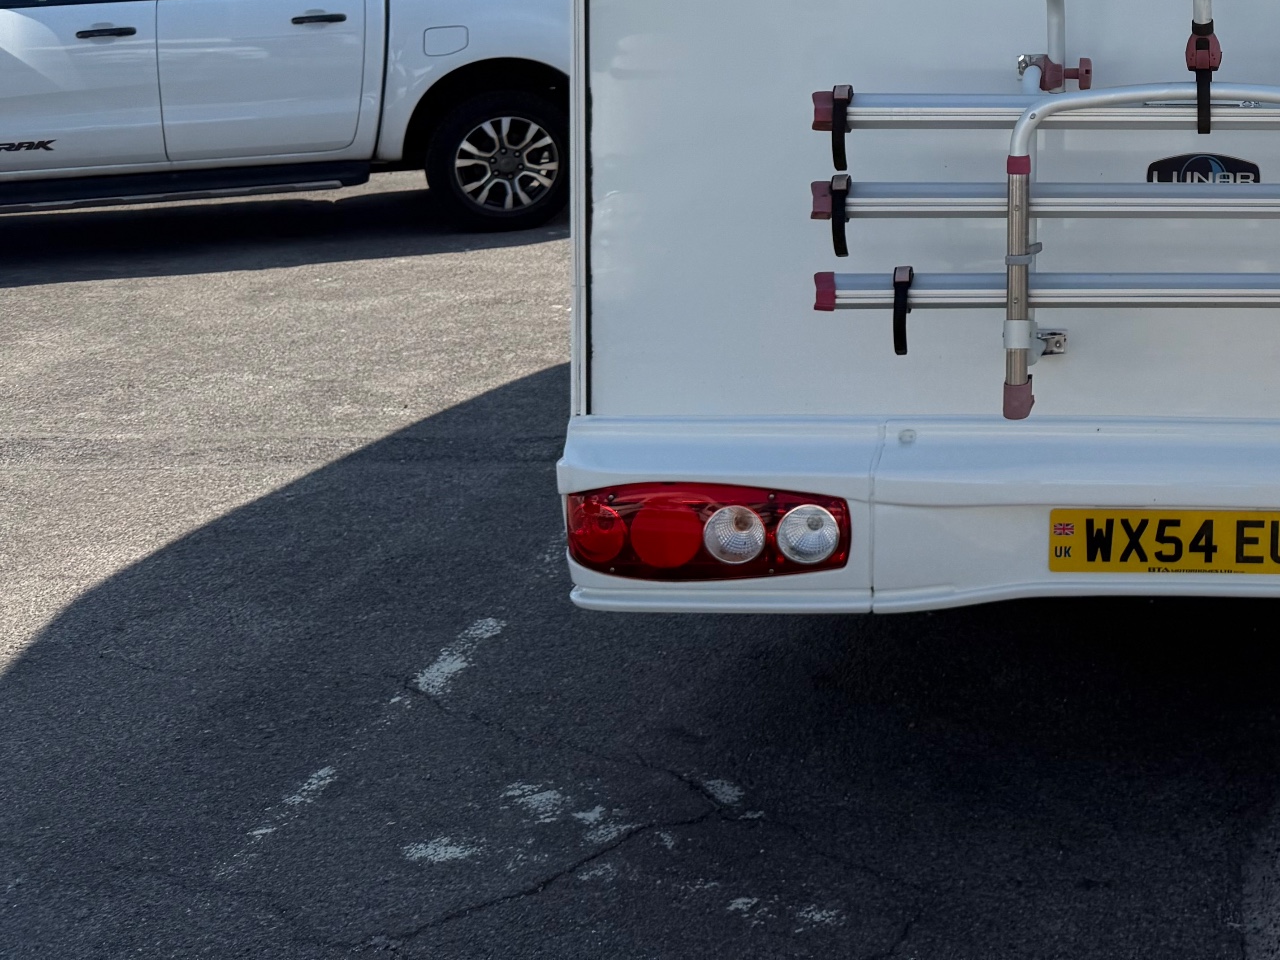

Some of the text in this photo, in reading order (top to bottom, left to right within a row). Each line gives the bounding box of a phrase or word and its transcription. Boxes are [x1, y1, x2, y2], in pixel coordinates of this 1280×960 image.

[1152, 170, 1255, 184] LUNAR
[1085, 518, 1218, 563] WX54
[1054, 546, 1072, 558] UK
